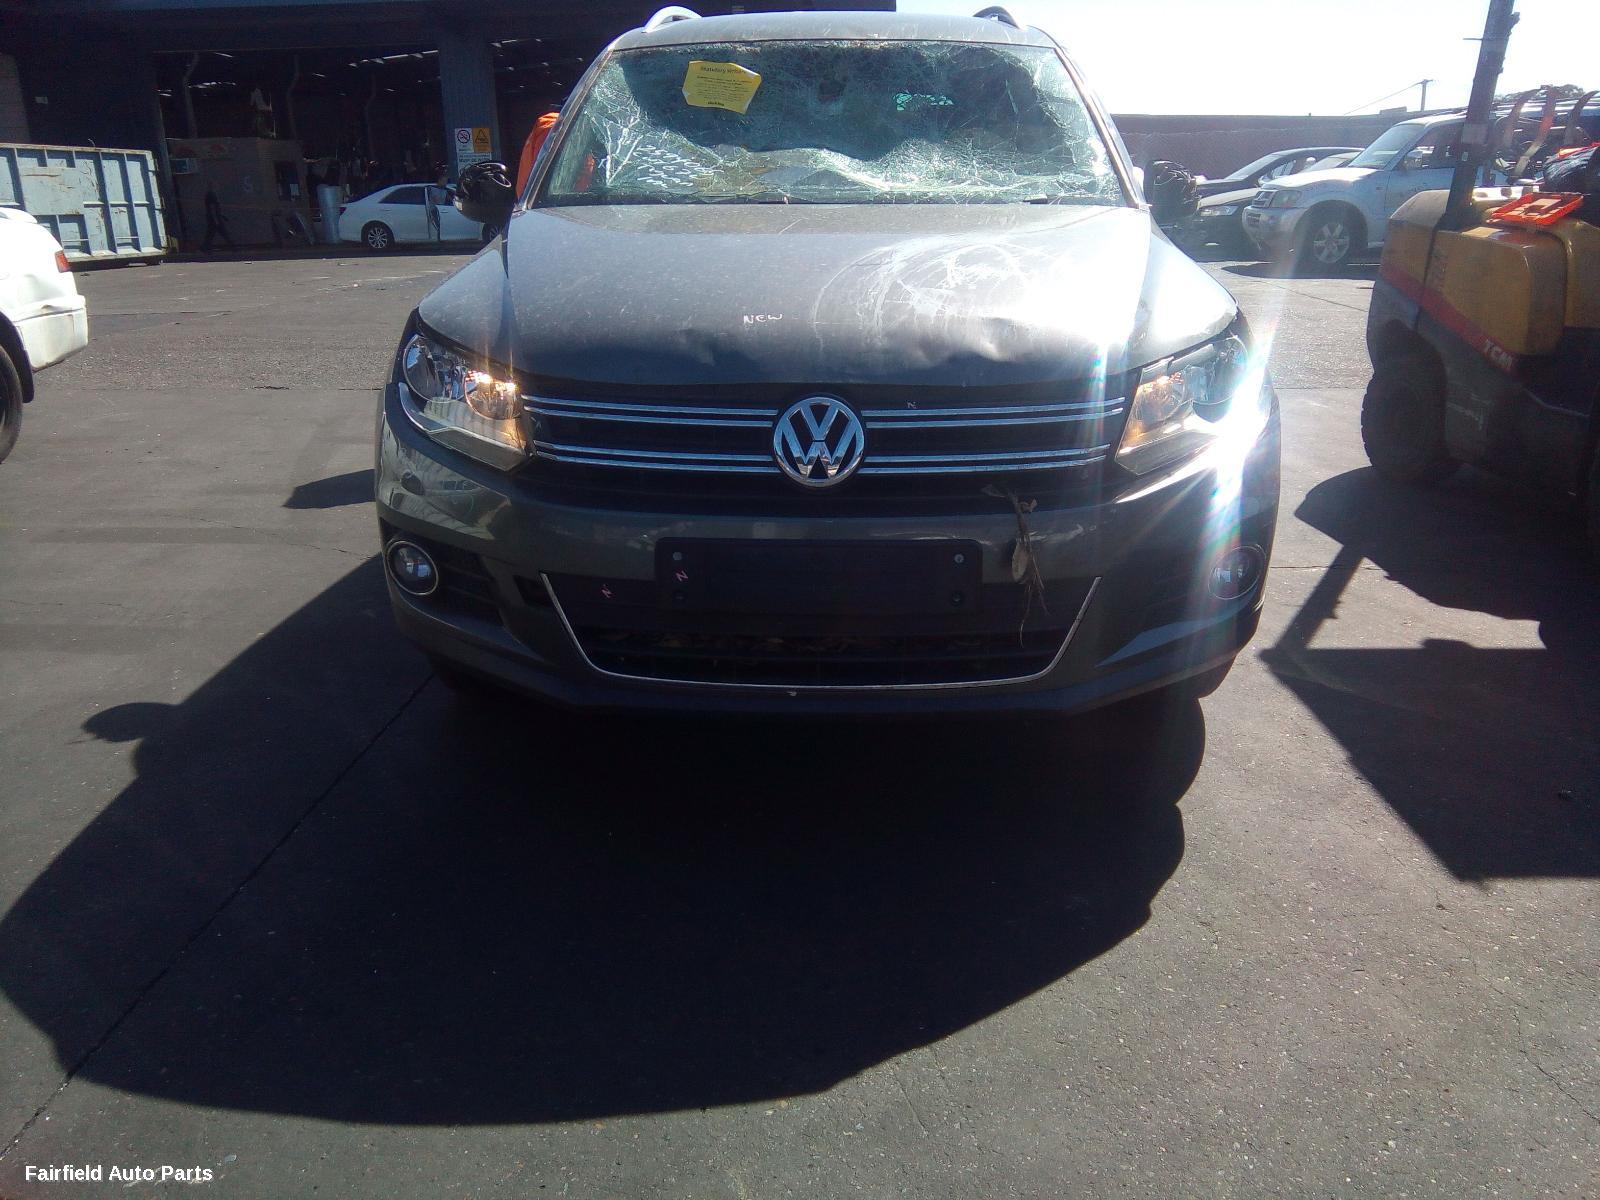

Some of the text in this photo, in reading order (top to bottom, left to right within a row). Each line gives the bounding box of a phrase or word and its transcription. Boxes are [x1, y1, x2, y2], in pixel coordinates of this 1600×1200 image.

[743, 313, 783, 325] NEW
[1483, 339, 1513, 369] TCM
[775, 397, 864, 486] VW
